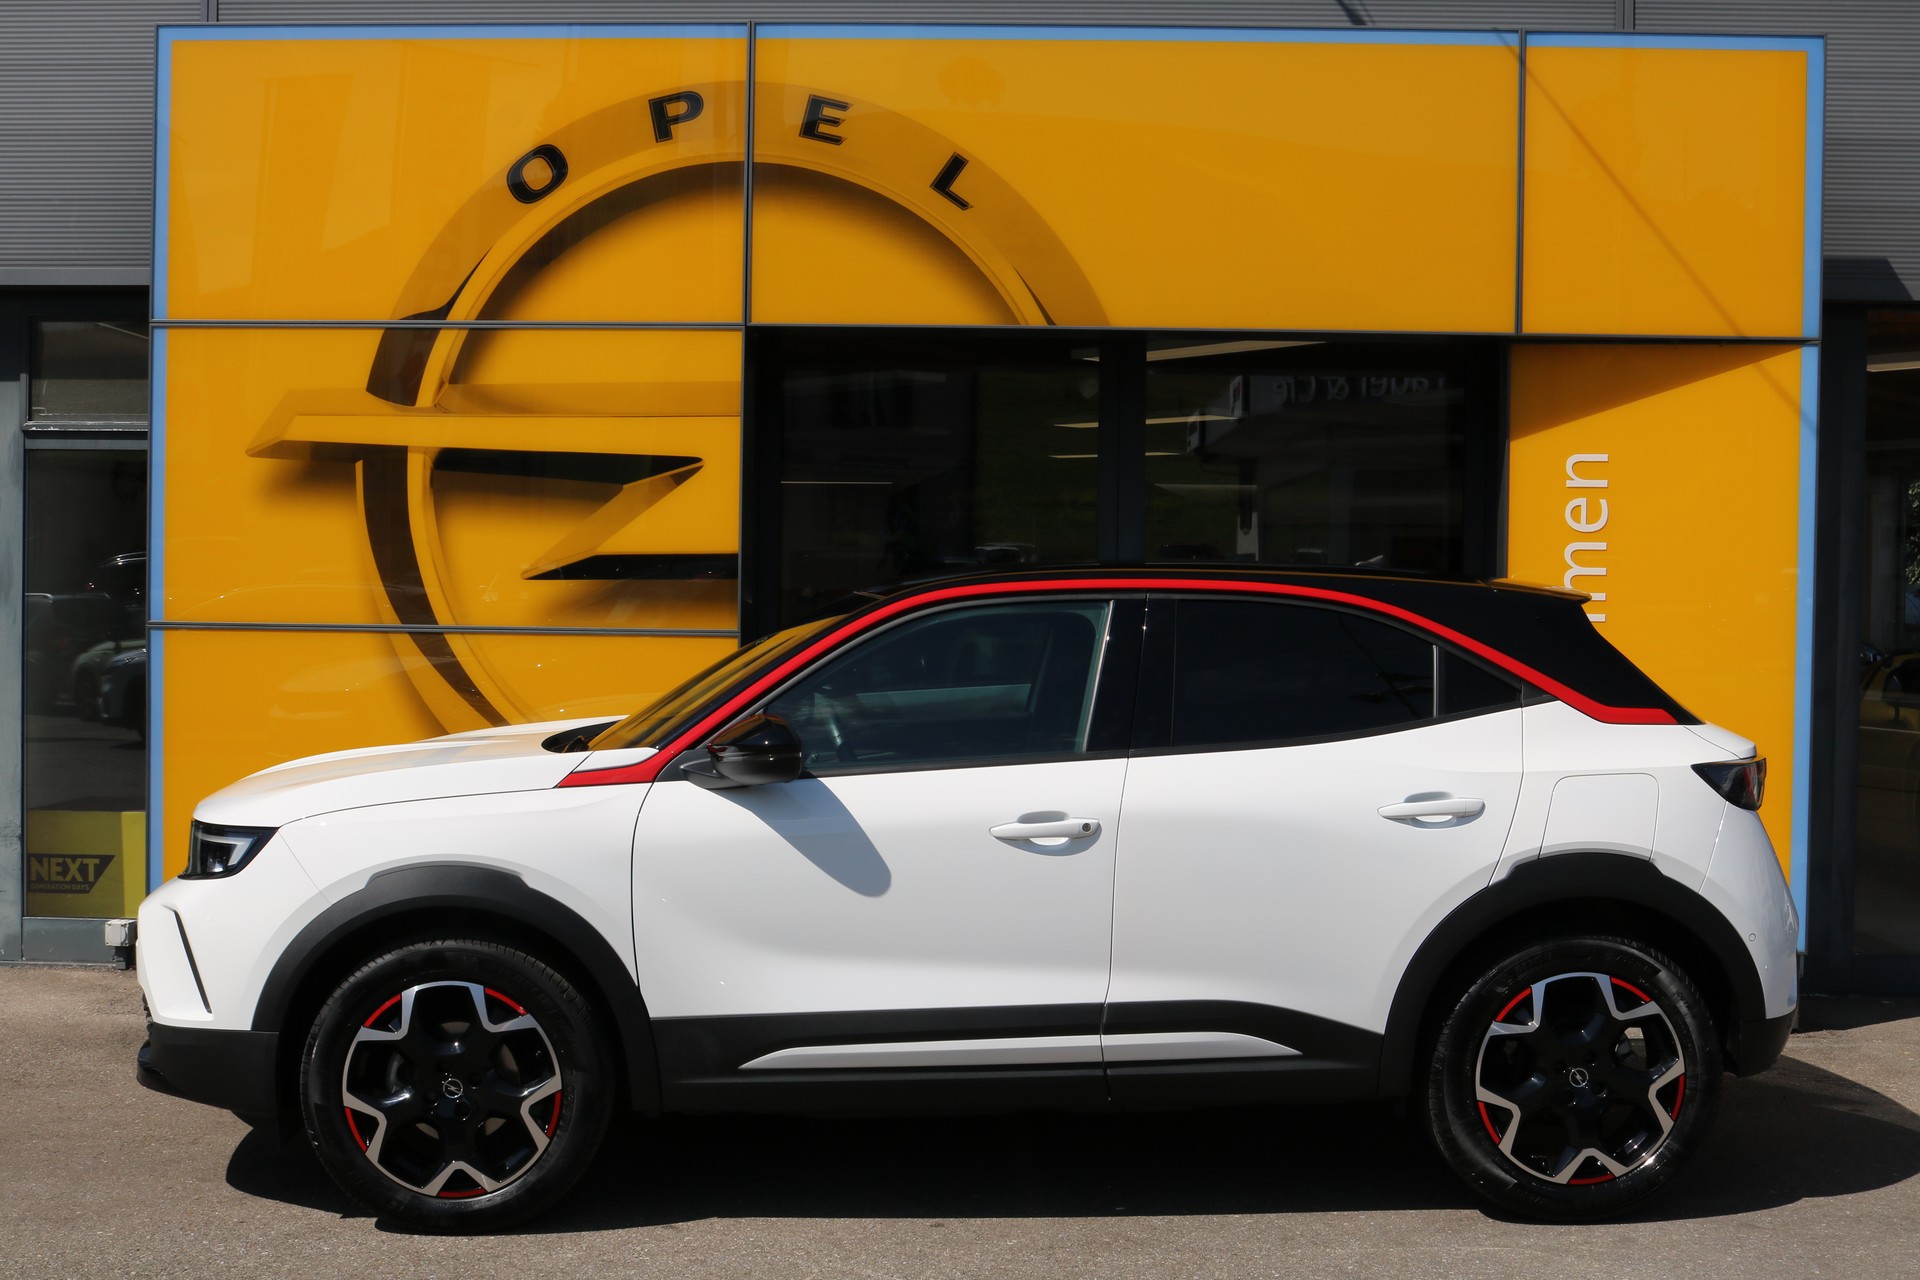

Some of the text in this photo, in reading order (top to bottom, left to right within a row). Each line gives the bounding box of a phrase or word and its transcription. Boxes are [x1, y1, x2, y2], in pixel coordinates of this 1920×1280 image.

[506, 90, 974, 211] OPEL
[1563, 453, 1609, 622] men
[30, 857, 100, 882] NEXT
[31, 883, 71, 891] GENERATION
